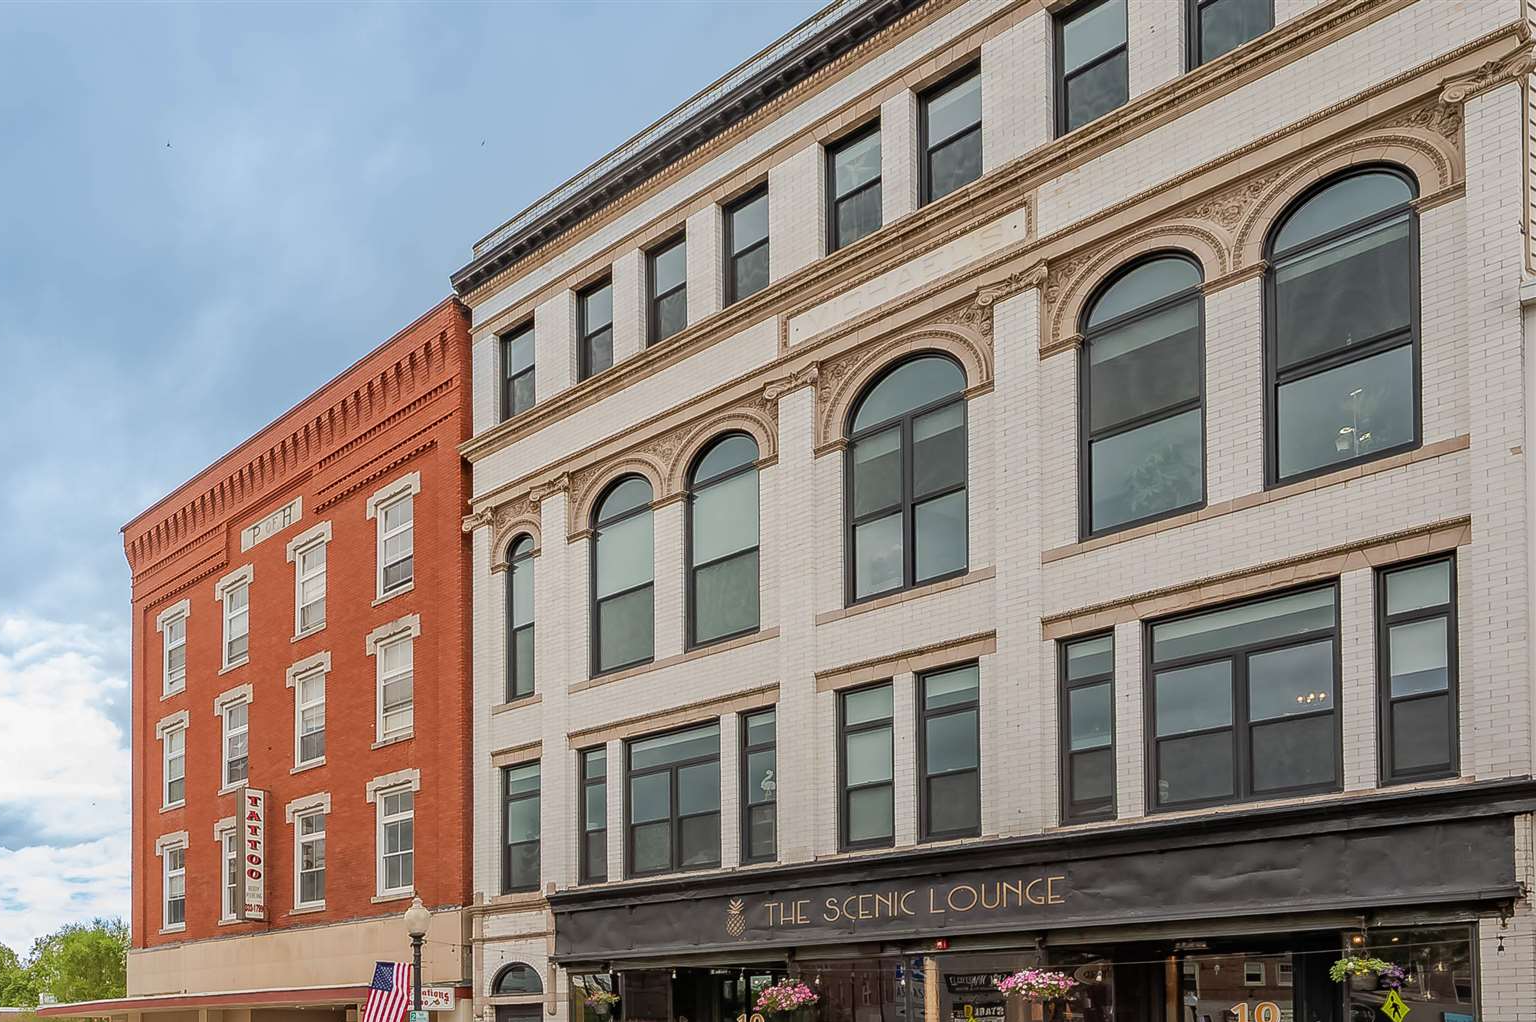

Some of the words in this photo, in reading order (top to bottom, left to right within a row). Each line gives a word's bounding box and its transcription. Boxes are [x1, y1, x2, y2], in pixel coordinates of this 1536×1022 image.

[246, 795, 262, 880] TATTOO
[764, 899, 811, 927] THE
[823, 889, 916, 922] SCENIC
[928, 876, 1066, 914] LOUNGE
